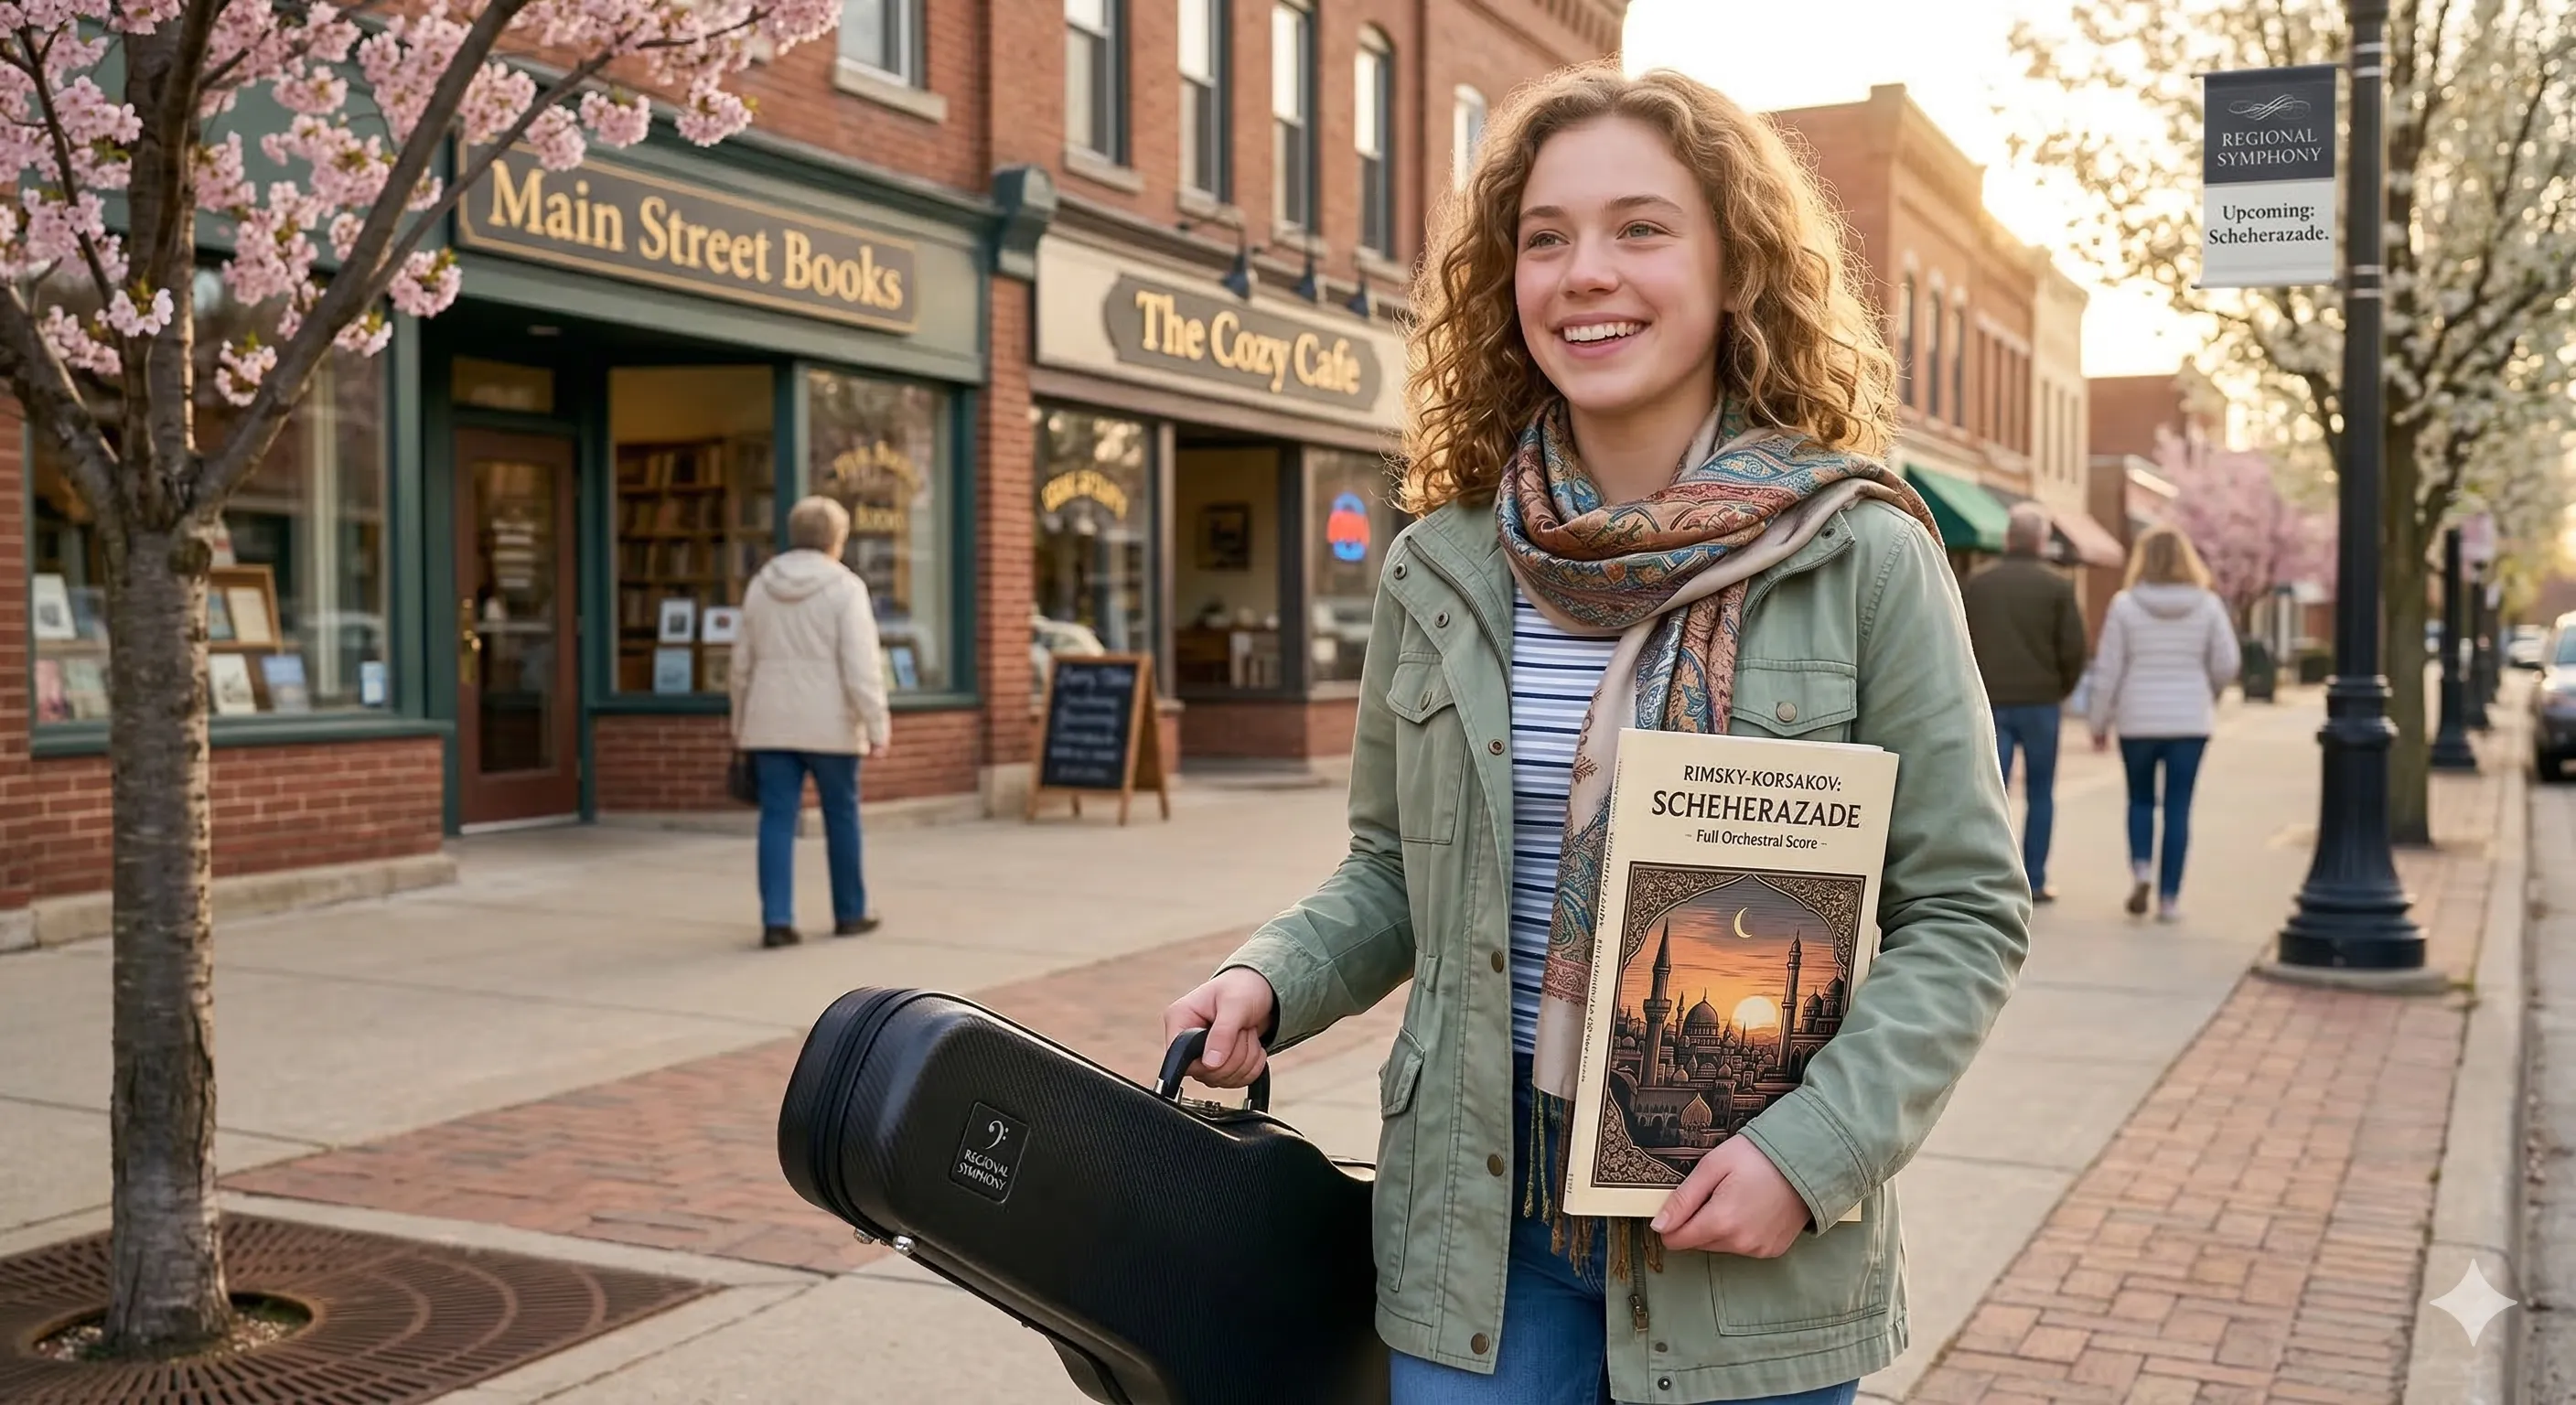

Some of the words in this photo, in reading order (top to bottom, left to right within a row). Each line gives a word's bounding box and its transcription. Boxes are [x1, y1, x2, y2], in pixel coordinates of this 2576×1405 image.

[2222, 128, 2318, 147] REGIONAL
[2217, 147, 2322, 166] SYMPHONY
[2223, 202, 2315, 224] Upcoming:
[488, 159, 626, 252] Main
[639, 196, 773, 284] Street
[783, 228, 904, 311] Books
[2208, 225, 2330, 245] Scheherazade.
[1135, 290, 1206, 361] The
[1210, 310, 1291, 393] Cozy
[1293, 332, 1361, 395] Cafe
[1684, 765, 1841, 792] RIMSKY-KORSAKOV:
[1651, 789, 1862, 829] SCHEHERAZADE
[1696, 830, 1719, 845] Full
[1722, 831, 1783, 848] Orchestral
[1786, 834, 1818, 850] Score
